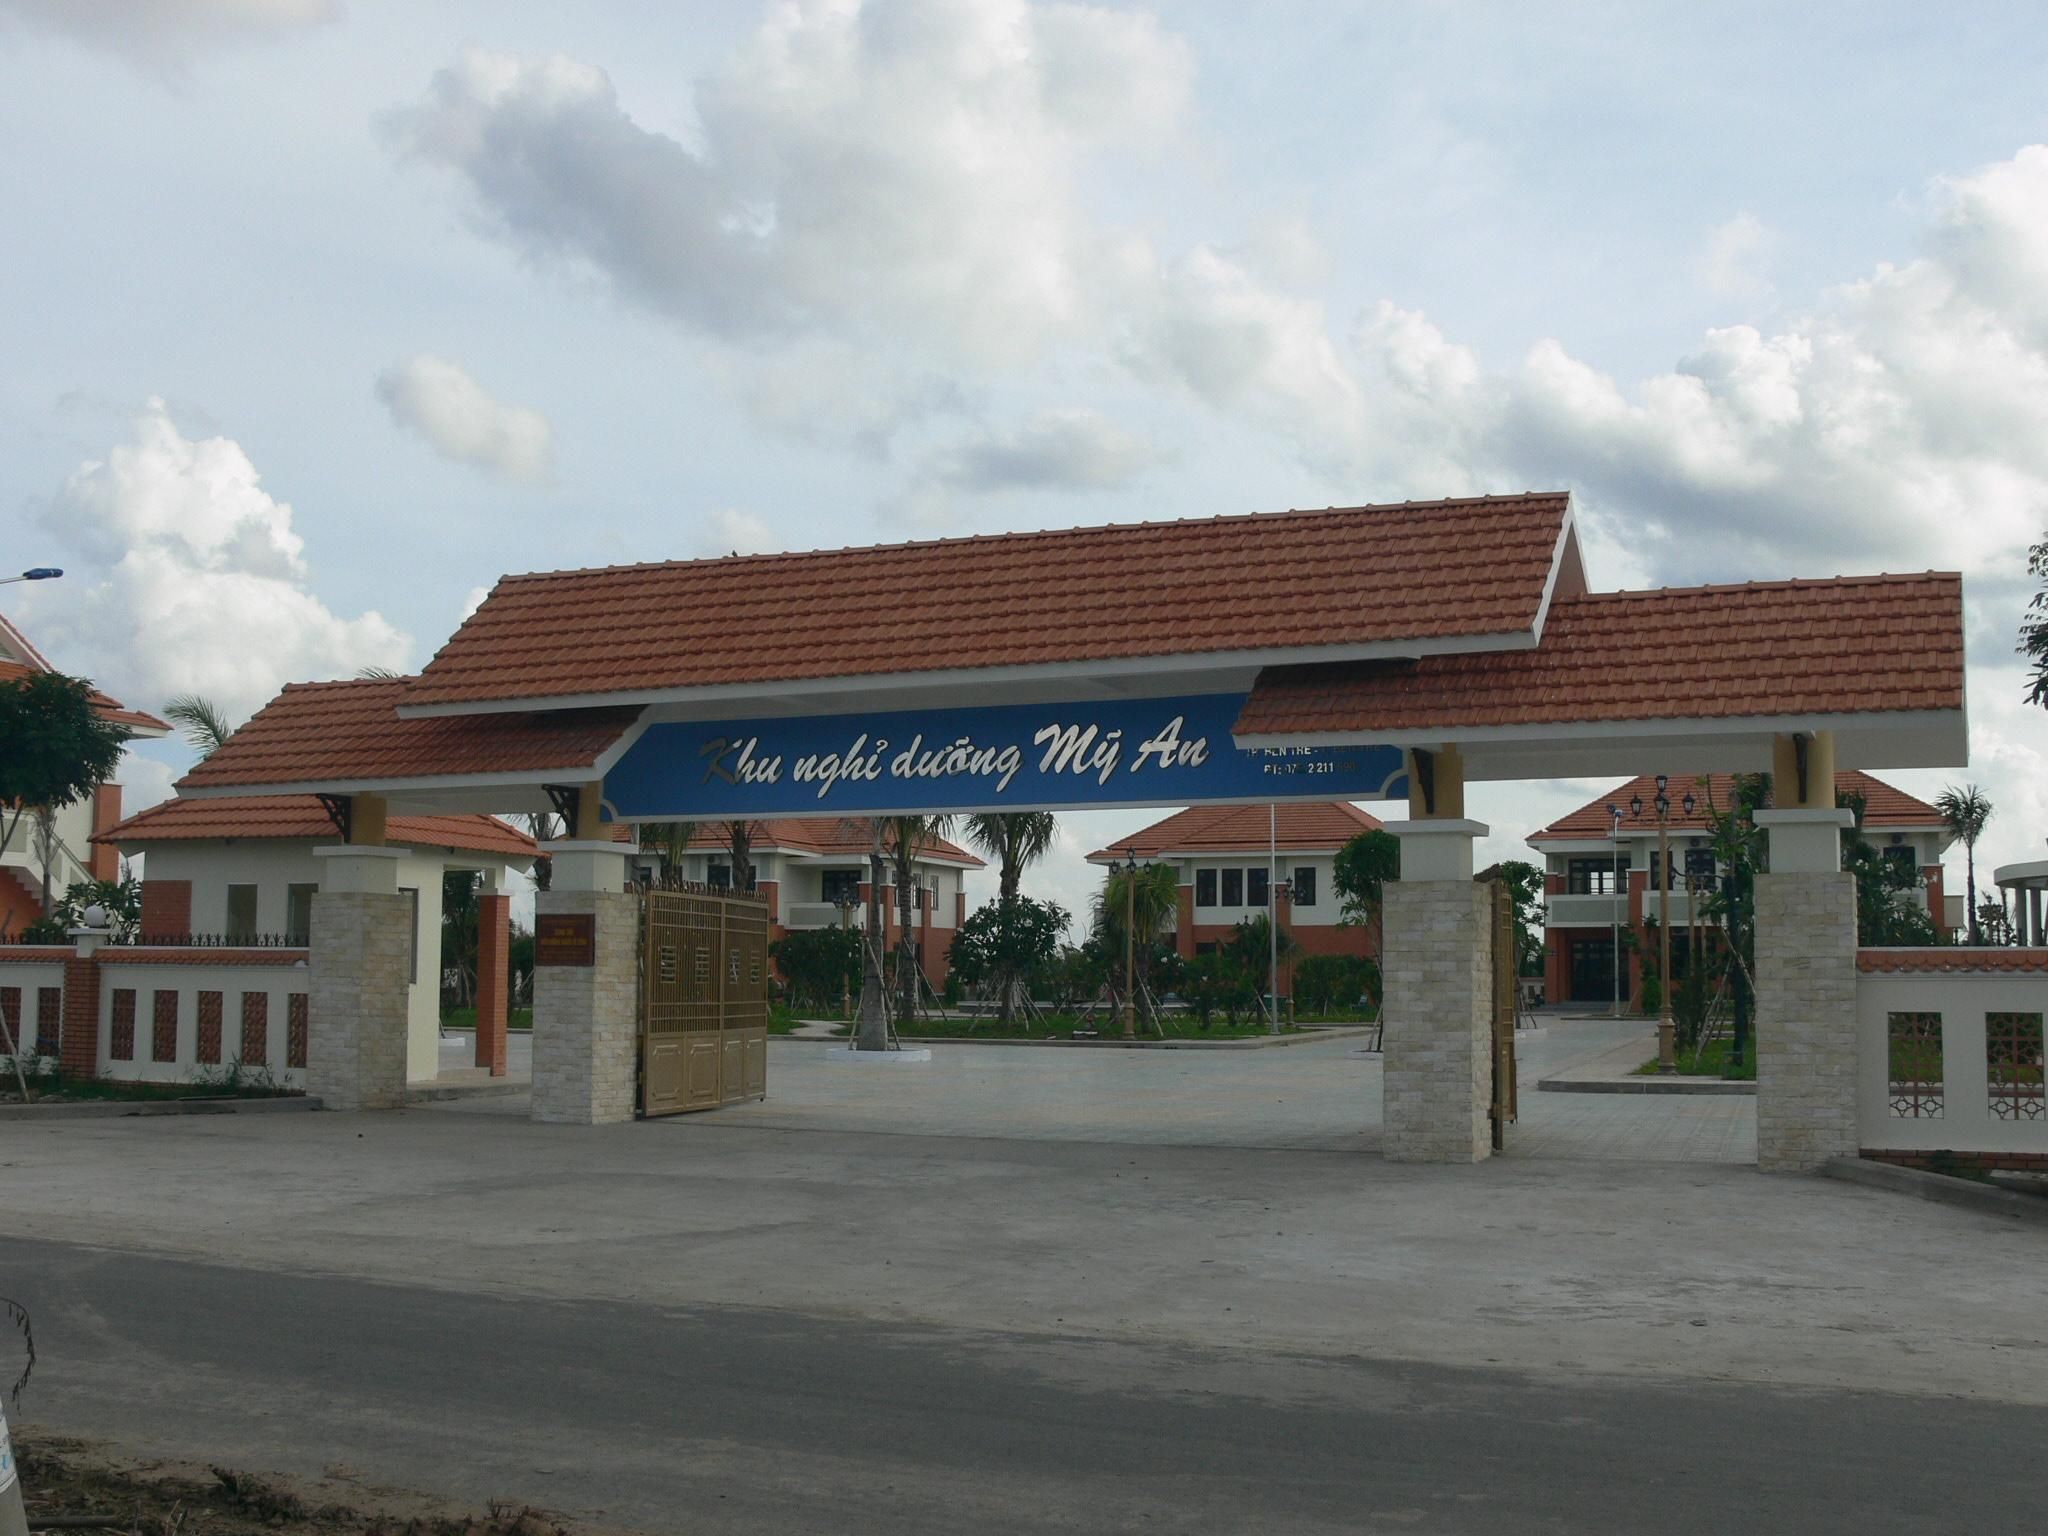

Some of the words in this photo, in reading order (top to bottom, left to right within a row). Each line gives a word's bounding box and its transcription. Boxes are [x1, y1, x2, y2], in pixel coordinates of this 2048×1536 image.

[698, 736, 784, 784] Khu
[792, 733, 888, 799] nghỉ
[890, 733, 1022, 792] dưỡng
[1033, 723, 1123, 786] Mỹ
[1130, 715, 1210, 773] An
